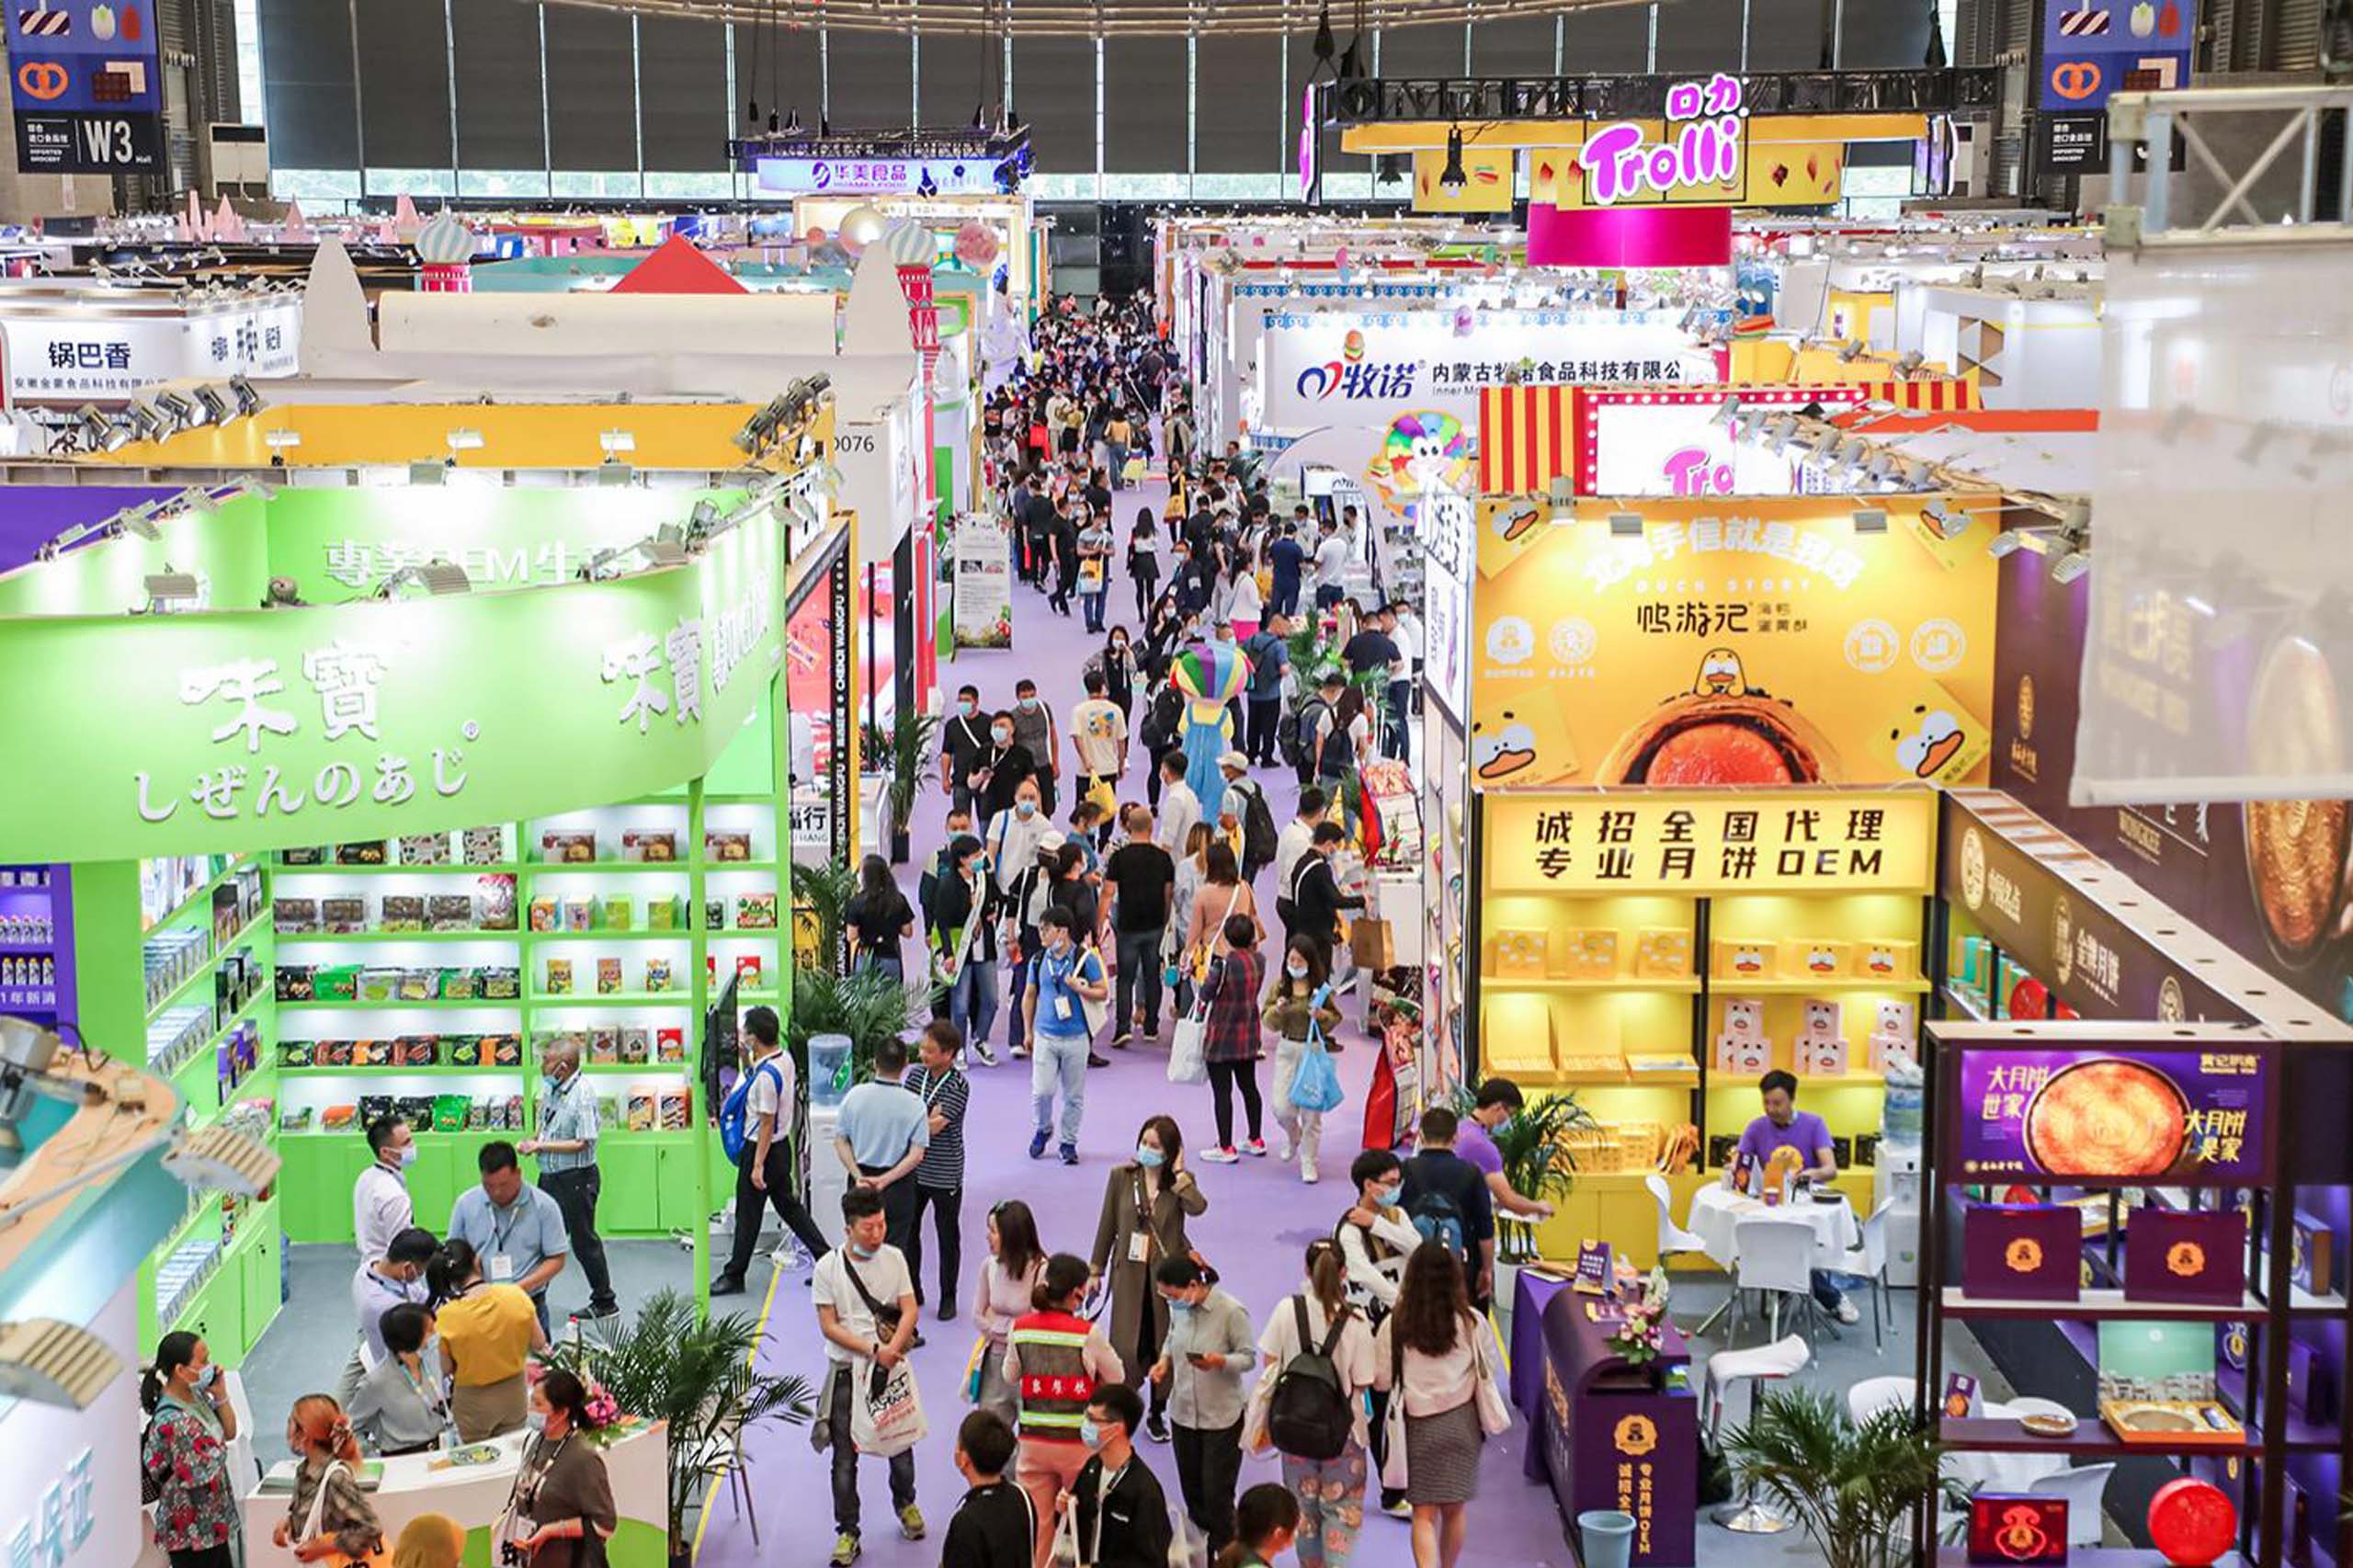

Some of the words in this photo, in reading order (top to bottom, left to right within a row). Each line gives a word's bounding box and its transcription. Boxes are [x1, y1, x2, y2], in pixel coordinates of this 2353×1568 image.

[1666, 74, 1741, 119] 口力
[84, 119, 133, 163] W3
[835, 164, 906, 181] 华美食品
[1580, 115, 1741, 205] Trolli
[49, 342, 131, 369] 锅巴香
[1341, 362, 1417, 398] 牧诺
[135, 747, 471, 823] しぜんのあじ
[1535, 811, 1884, 843] 诚招全国代理
[1986, 1065, 2050, 1092] 大月饼
[1982, 1094, 2025, 1119] 世家
[2184, 1108, 2248, 1137] 大月饼
[1619, 1462, 1633, 1517] 诚招全
